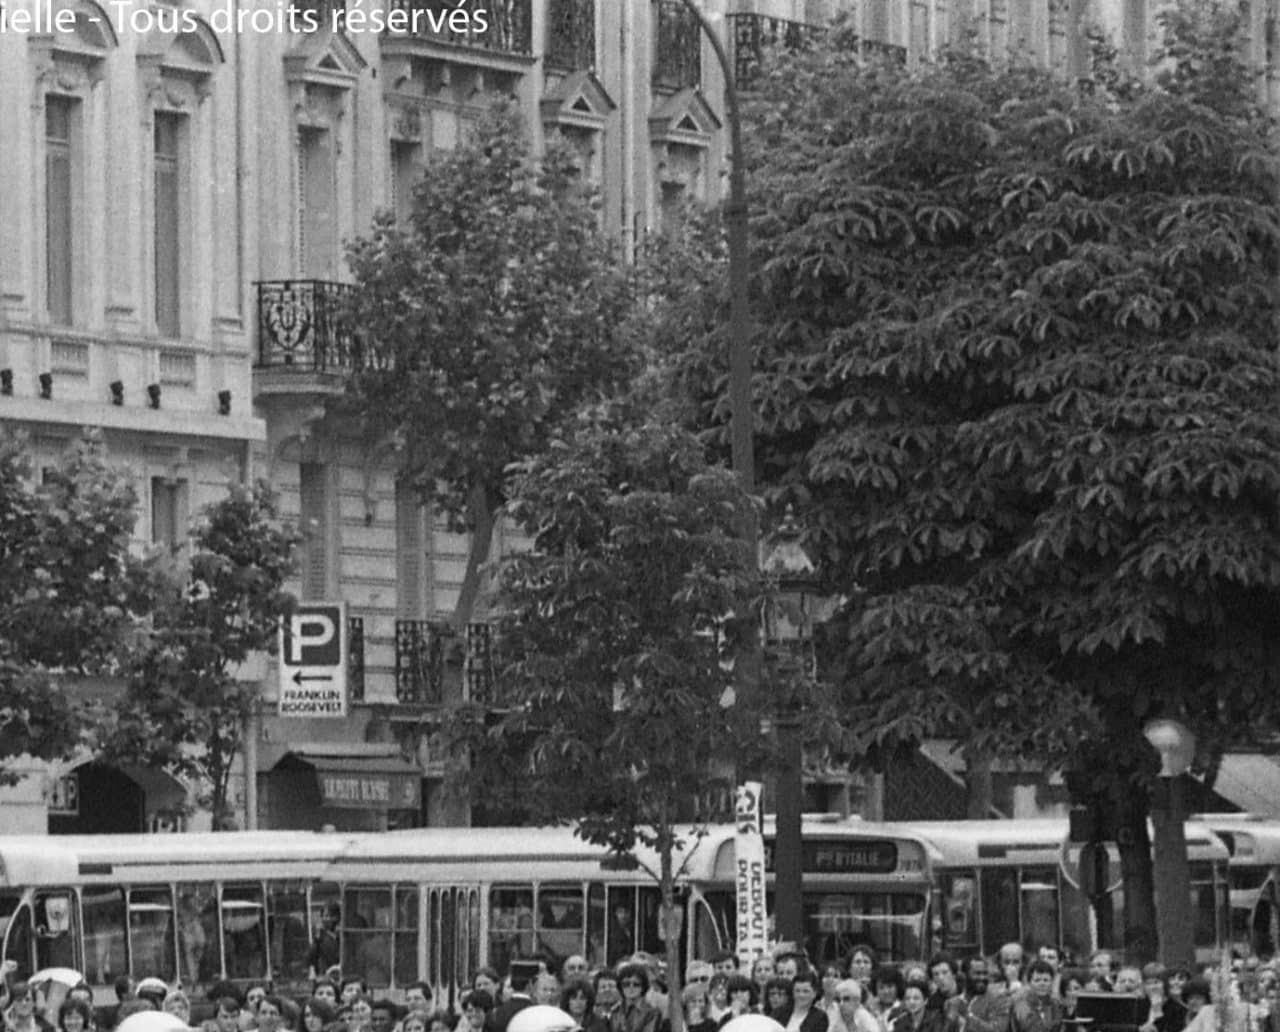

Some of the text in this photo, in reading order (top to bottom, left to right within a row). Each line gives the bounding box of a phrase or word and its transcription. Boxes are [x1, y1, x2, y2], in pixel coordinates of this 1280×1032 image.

[291, 614, 335, 662] P
[284, 689, 340, 700] FRANKLIN
[281, 701, 341, 712] ROOSEVELT
